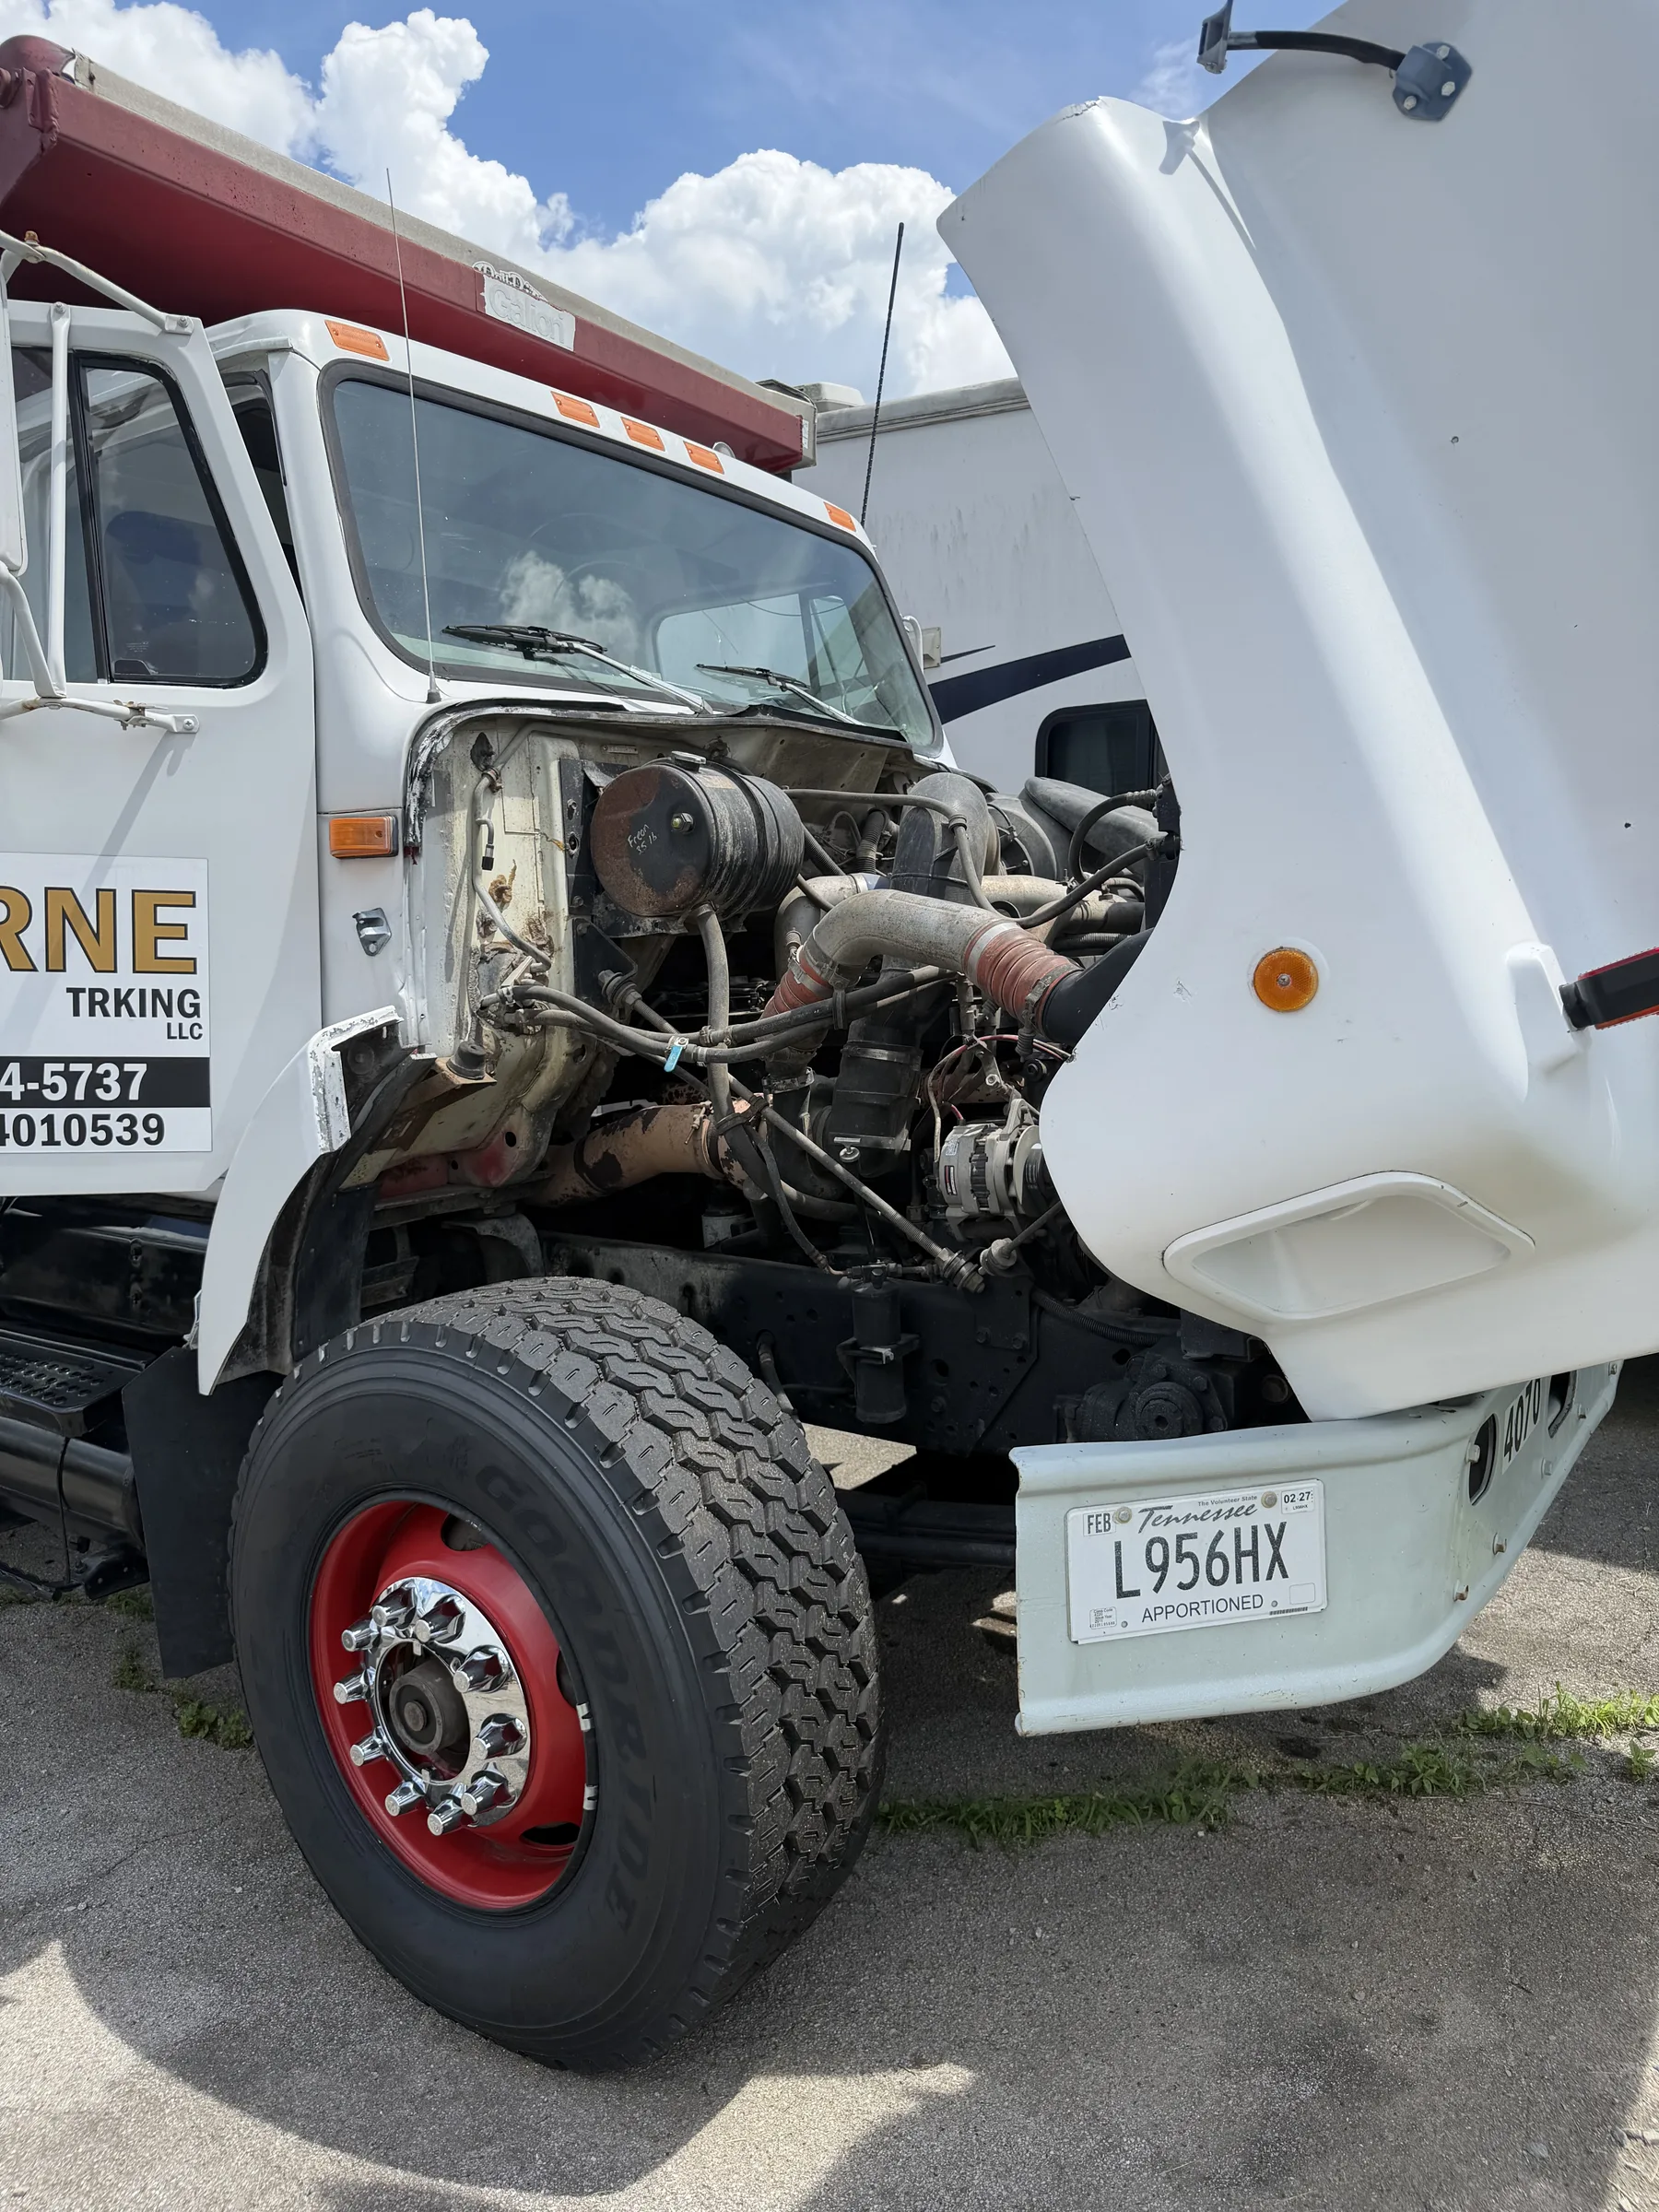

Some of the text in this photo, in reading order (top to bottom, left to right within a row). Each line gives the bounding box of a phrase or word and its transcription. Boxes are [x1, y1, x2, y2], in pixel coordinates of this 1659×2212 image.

[627, 824, 651, 848] Freon
[65, 986, 201, 1019] TRKING
[166, 1022, 204, 1041] LLC
[0, 1062, 147, 1101] 4-5737
[1210, 1497, 1241, 1505] Volunteer
[1087, 1512, 1112, 1535] FEB
[1137, 1503, 1258, 1534] Tennessee
[1113, 1521, 1289, 1599] L956HX
[1141, 1594, 1264, 1623] APPORTIONED
